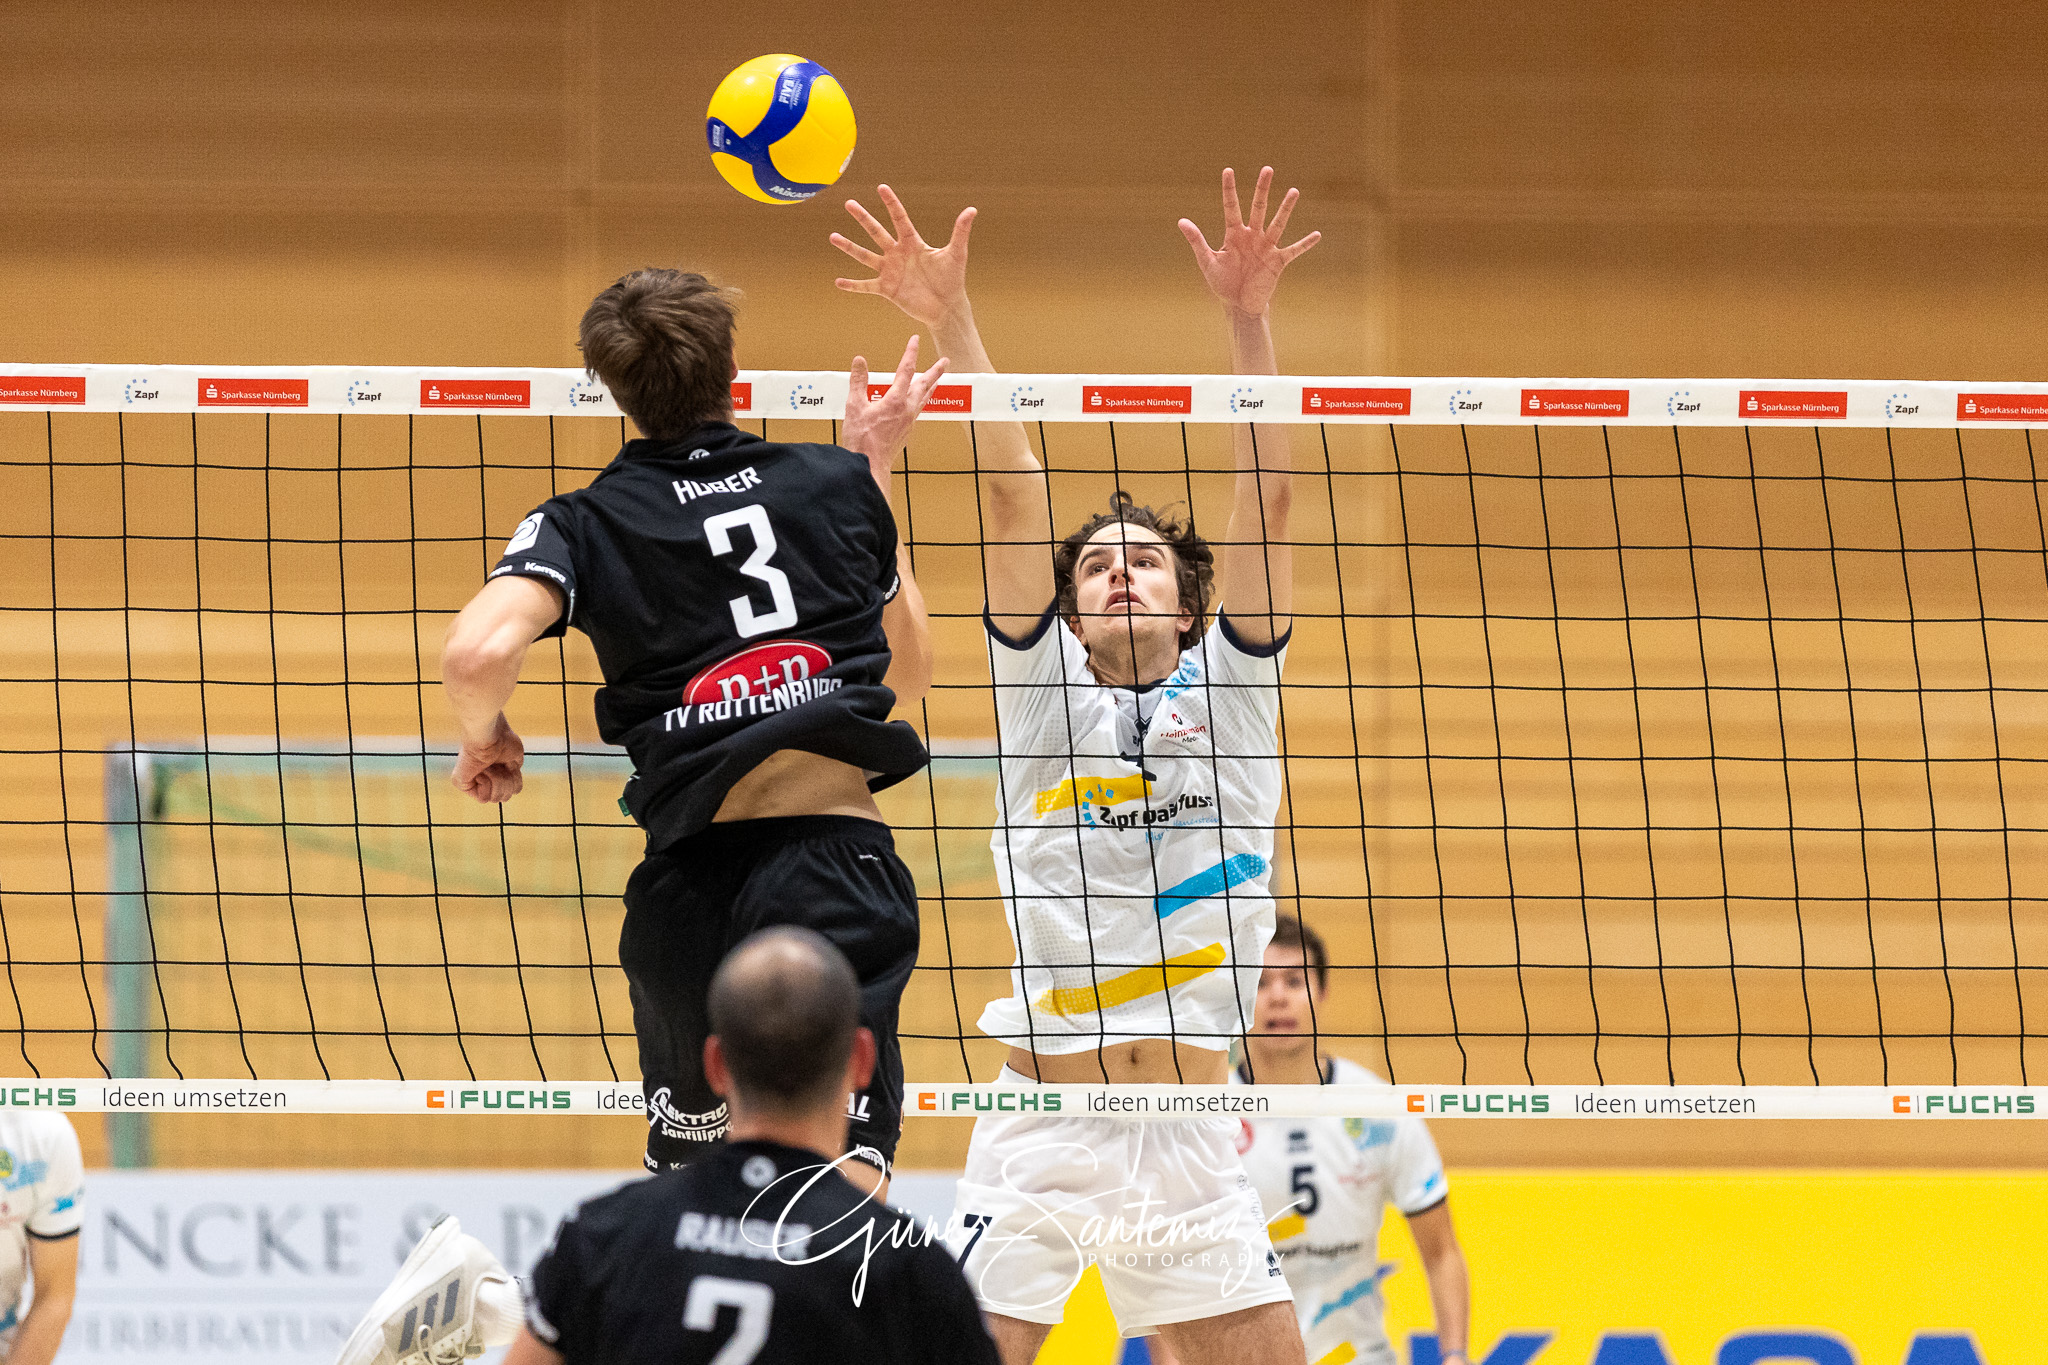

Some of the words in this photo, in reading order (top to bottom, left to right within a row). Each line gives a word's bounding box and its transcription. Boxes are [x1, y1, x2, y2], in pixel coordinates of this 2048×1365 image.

[40, 389, 78, 399] Nürnberg
[134, 390, 159, 401] Zapf
[221, 390, 261, 400] Sparkasse
[263, 391, 301, 401] Nürnberg
[357, 392, 382, 402] Zapf
[443, 391, 483, 402] Sparkasse
[485, 392, 523, 403] Nürnberg
[579, 393, 604, 404] Zapf
[800, 396, 824, 406] Zapf
[926, 396, 964, 407] Nürnberg
[1020, 398, 1044, 408] Zapf
[1105, 397, 1145, 408] Sparkasse
[1146, 398, 1184, 409] Nürnberg
[1239, 399, 1264, 409] Zapf
[1325, 399, 1364, 410] Sparkasse
[1366, 399, 1403, 410] Nürnberg
[1459, 401, 1483, 411] Zapf
[1543, 401, 1583, 411] Sparkasse
[1584, 402, 1622, 412] Nürnberg
[1676, 402, 1701, 412] Zapf
[1761, 403, 1801, 413] Sparkasse
[1802, 403, 1840, 414] Nürnberg
[1895, 404, 1919, 415] Zapf
[1979, 405, 2019, 415] Sparkasse
[2020, 405, 2048, 415] Nürnbe
[672, 466, 763, 504] HUBER
[524, 561, 567, 583] Kempa
[703, 503, 798, 639] 3
[663, 704, 692, 732] TV
[103, 1086, 165, 1107] Ideen
[173, 1088, 287, 1107] umsetzen
[460, 1090, 571, 1109] FUCHS
[597, 1088, 645, 1110] Idee
[951, 1092, 1062, 1111] FUCHS
[1087, 1090, 1149, 1112] Ideen
[1157, 1093, 1270, 1112] umsetzen
[1440, 1094, 1550, 1113] FUCHS
[1575, 1092, 1636, 1113] Ideen
[1645, 1094, 1756, 1113] umsetzen
[1926, 1095, 2035, 1113] FUCHS
[1290, 1164, 1321, 1217] 5
[80, 1203, 362, 1276] NCKE
